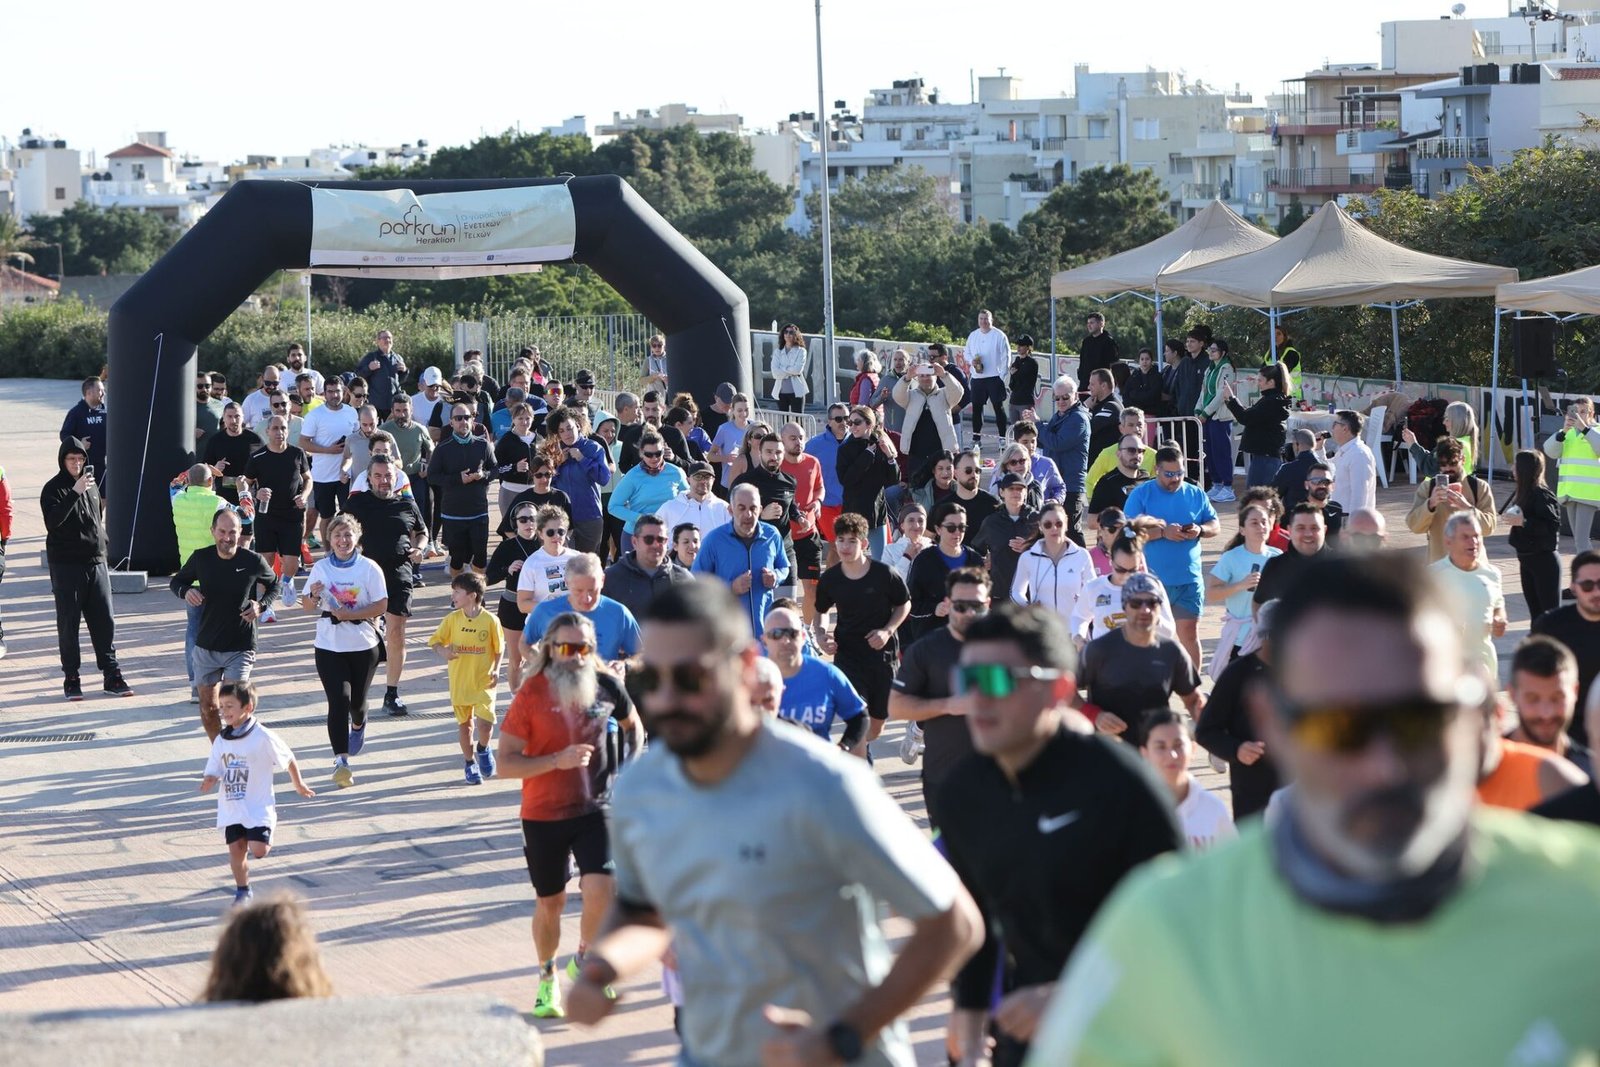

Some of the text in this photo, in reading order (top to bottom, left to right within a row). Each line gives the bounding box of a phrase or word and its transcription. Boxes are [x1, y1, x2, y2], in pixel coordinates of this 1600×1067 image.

[379, 212, 456, 238] parkrun
[416, 236, 456, 245] Heraklion
[223, 783, 247, 793] RETE
